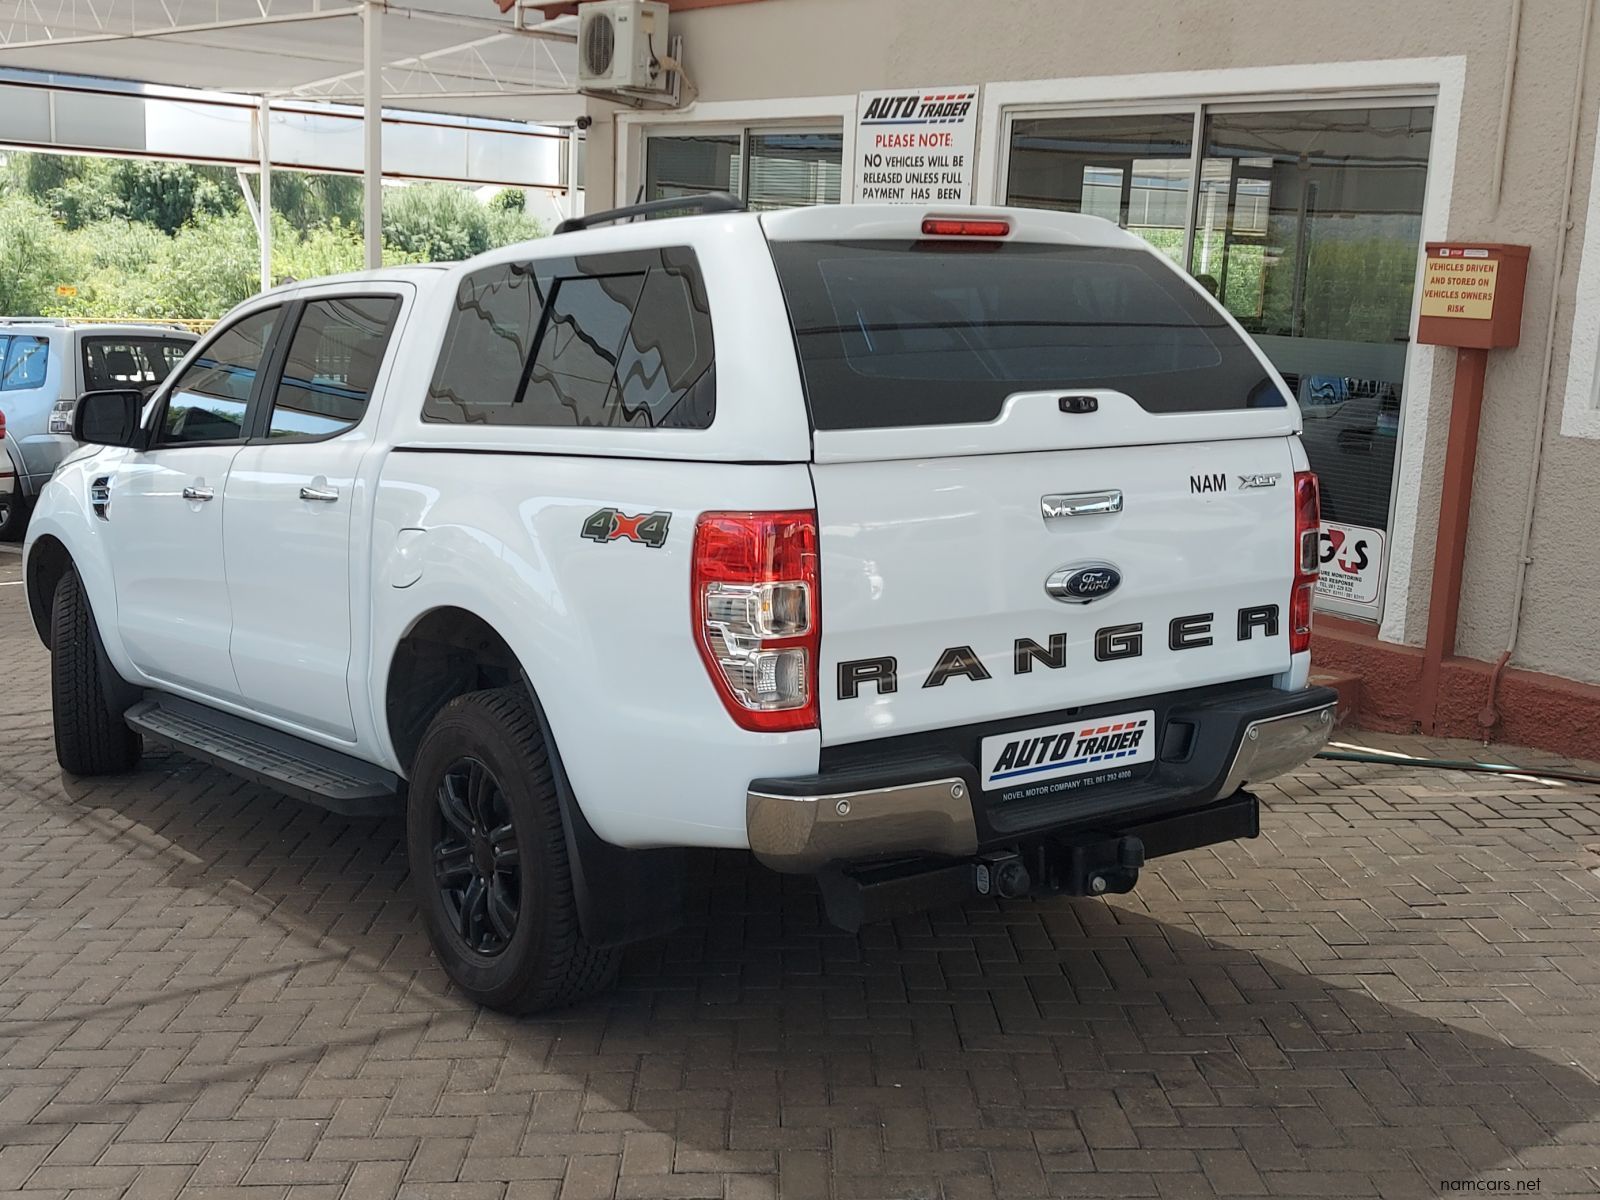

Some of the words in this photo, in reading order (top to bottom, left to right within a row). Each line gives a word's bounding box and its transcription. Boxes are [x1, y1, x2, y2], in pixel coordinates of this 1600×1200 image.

[863, 96, 920, 119] AUTO
[918, 101, 971, 118] TRADER
[876, 134, 915, 147] PLEASE
[919, 133, 953, 147] NOTE:
[864, 154, 882, 168] NO
[886, 156, 924, 167] VEHICLES
[928, 156, 949, 167] WILL
[953, 156, 964, 167] BE
[863, 172, 902, 184] RELEASED
[905, 173, 939, 184] UNLESS
[941, 172, 962, 184] FULL
[863, 188, 904, 200] PAYMENT
[911, 188, 930, 200] HAS
[937, 188, 961, 200] BEEN
[1429, 262, 1464, 272] VEHICLES
[1466, 263, 1494, 273] DRIVEN
[1430, 276, 1446, 285] AND
[1447, 277, 1476, 286] STORED
[1478, 278, 1489, 287] ON
[1424, 290, 1459, 299] VEHICLES
[1461, 291, 1493, 301] OWNERS
[1447, 304, 1465, 313] RISK
[1190, 473, 1227, 494] NAM
[1237, 472, 1282, 490] XLT
[1320, 529, 1369, 574] G4S
[1079, 572, 1111, 592] Ford
[1329, 577, 1355, 588] RESPONSE
[1332, 571, 1363, 583] MONITORING
[836, 603, 1280, 700] RANGER
[992, 732, 1075, 772] AUTO
[1074, 729, 1144, 758] TRADER
[1002, 791, 1025, 802] NOVEL
[1026, 786, 1049, 797] MOTOR
[1049, 779, 1081, 793] COMPANY
[1083, 777, 1095, 787] TEL
